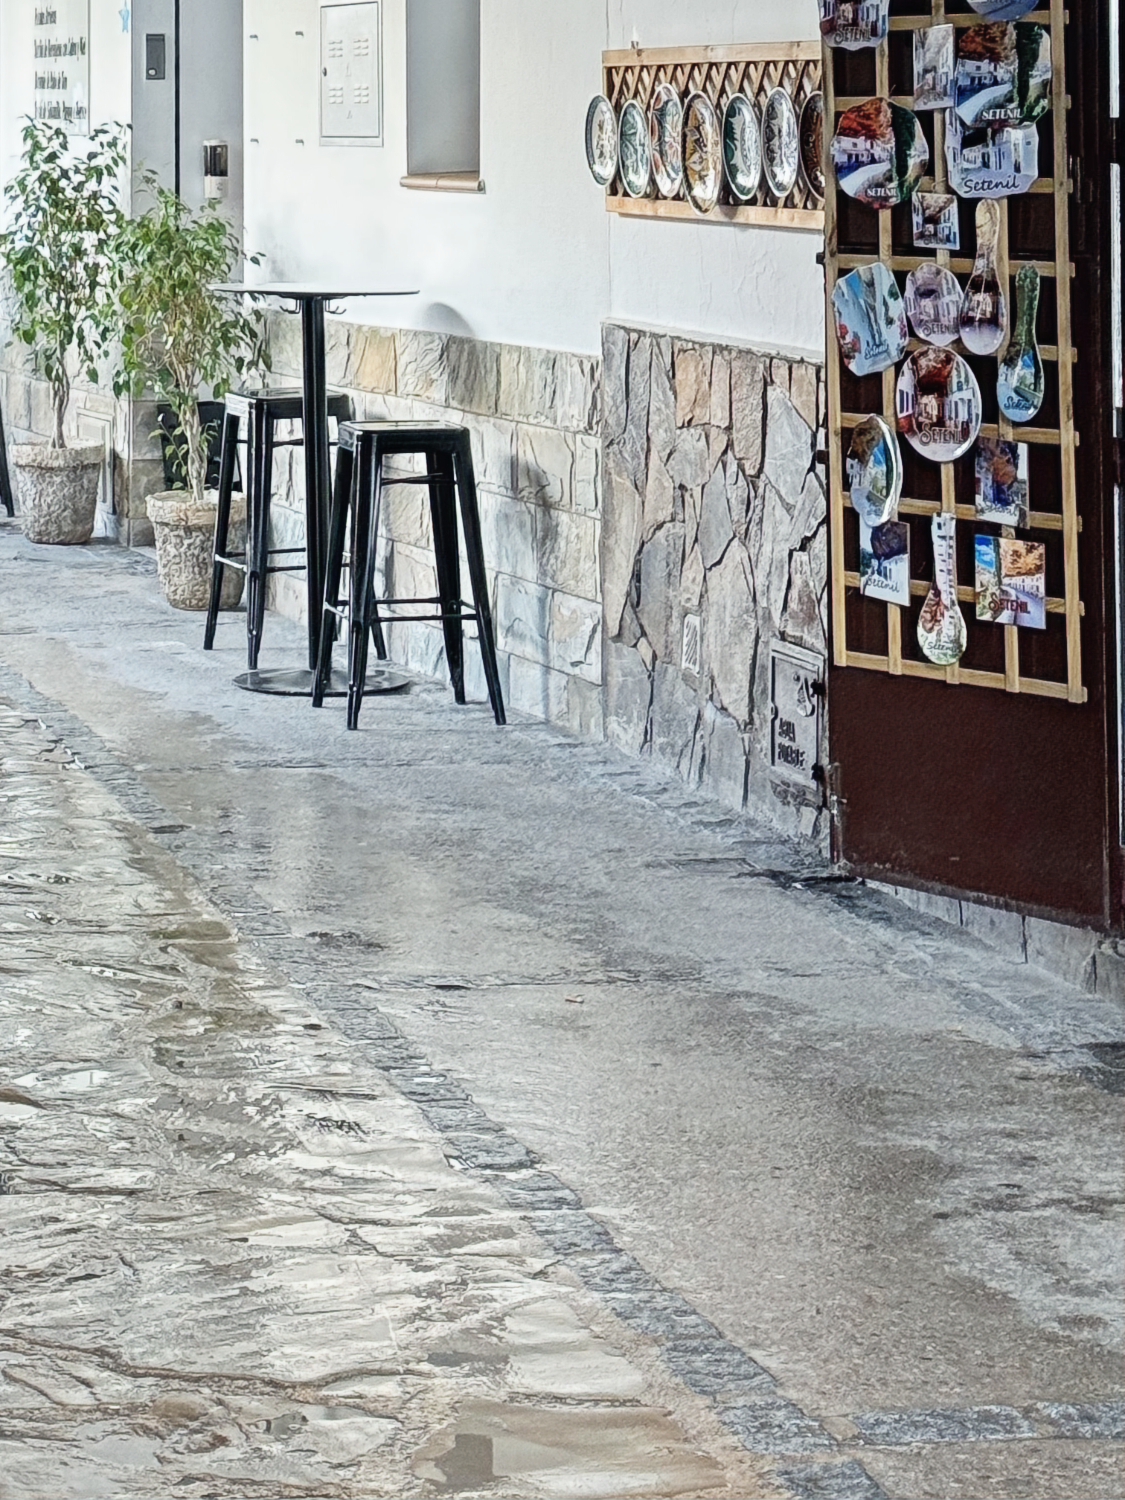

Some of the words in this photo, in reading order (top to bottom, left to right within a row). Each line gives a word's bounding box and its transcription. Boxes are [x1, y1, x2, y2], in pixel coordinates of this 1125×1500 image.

[981, 108, 1023, 120] SETENIL
[963, 175, 1020, 194] Setenil
[918, 421, 965, 446] SETENIL
[988, 592, 1031, 615] SETENIL
